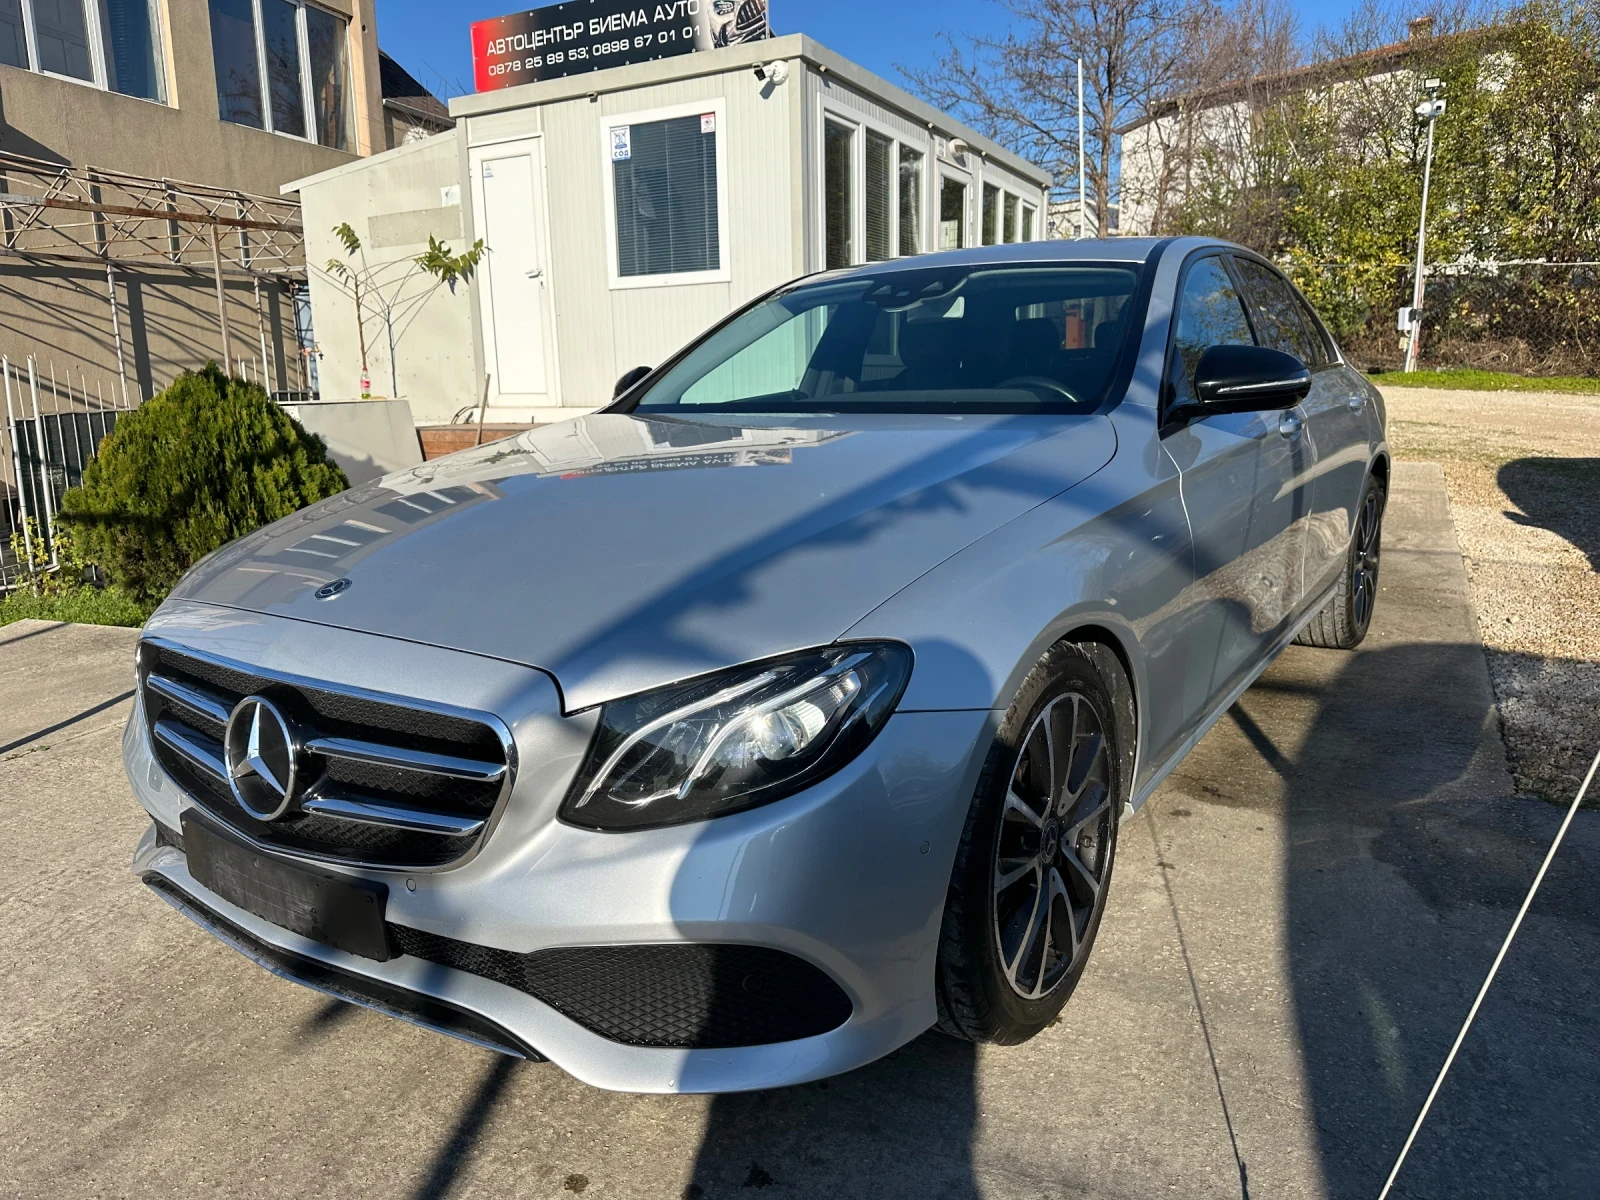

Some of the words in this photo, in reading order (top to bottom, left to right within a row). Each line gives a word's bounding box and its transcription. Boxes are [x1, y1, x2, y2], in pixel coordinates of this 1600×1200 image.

[486, 22, 584, 56] АВТОЦЕНТЪР
[589, 9, 648, 36] БИЕМА
[653, 0, 700, 23] АУТО
[488, 60, 521, 76] 0878
[525, 56, 543, 69] 25
[546, 51, 564, 65] 89
[592, 39, 630, 56] 0898
[634, 34, 653, 48] 67
[658, 31, 676, 43] 01
[682, 25, 700, 38] 01
